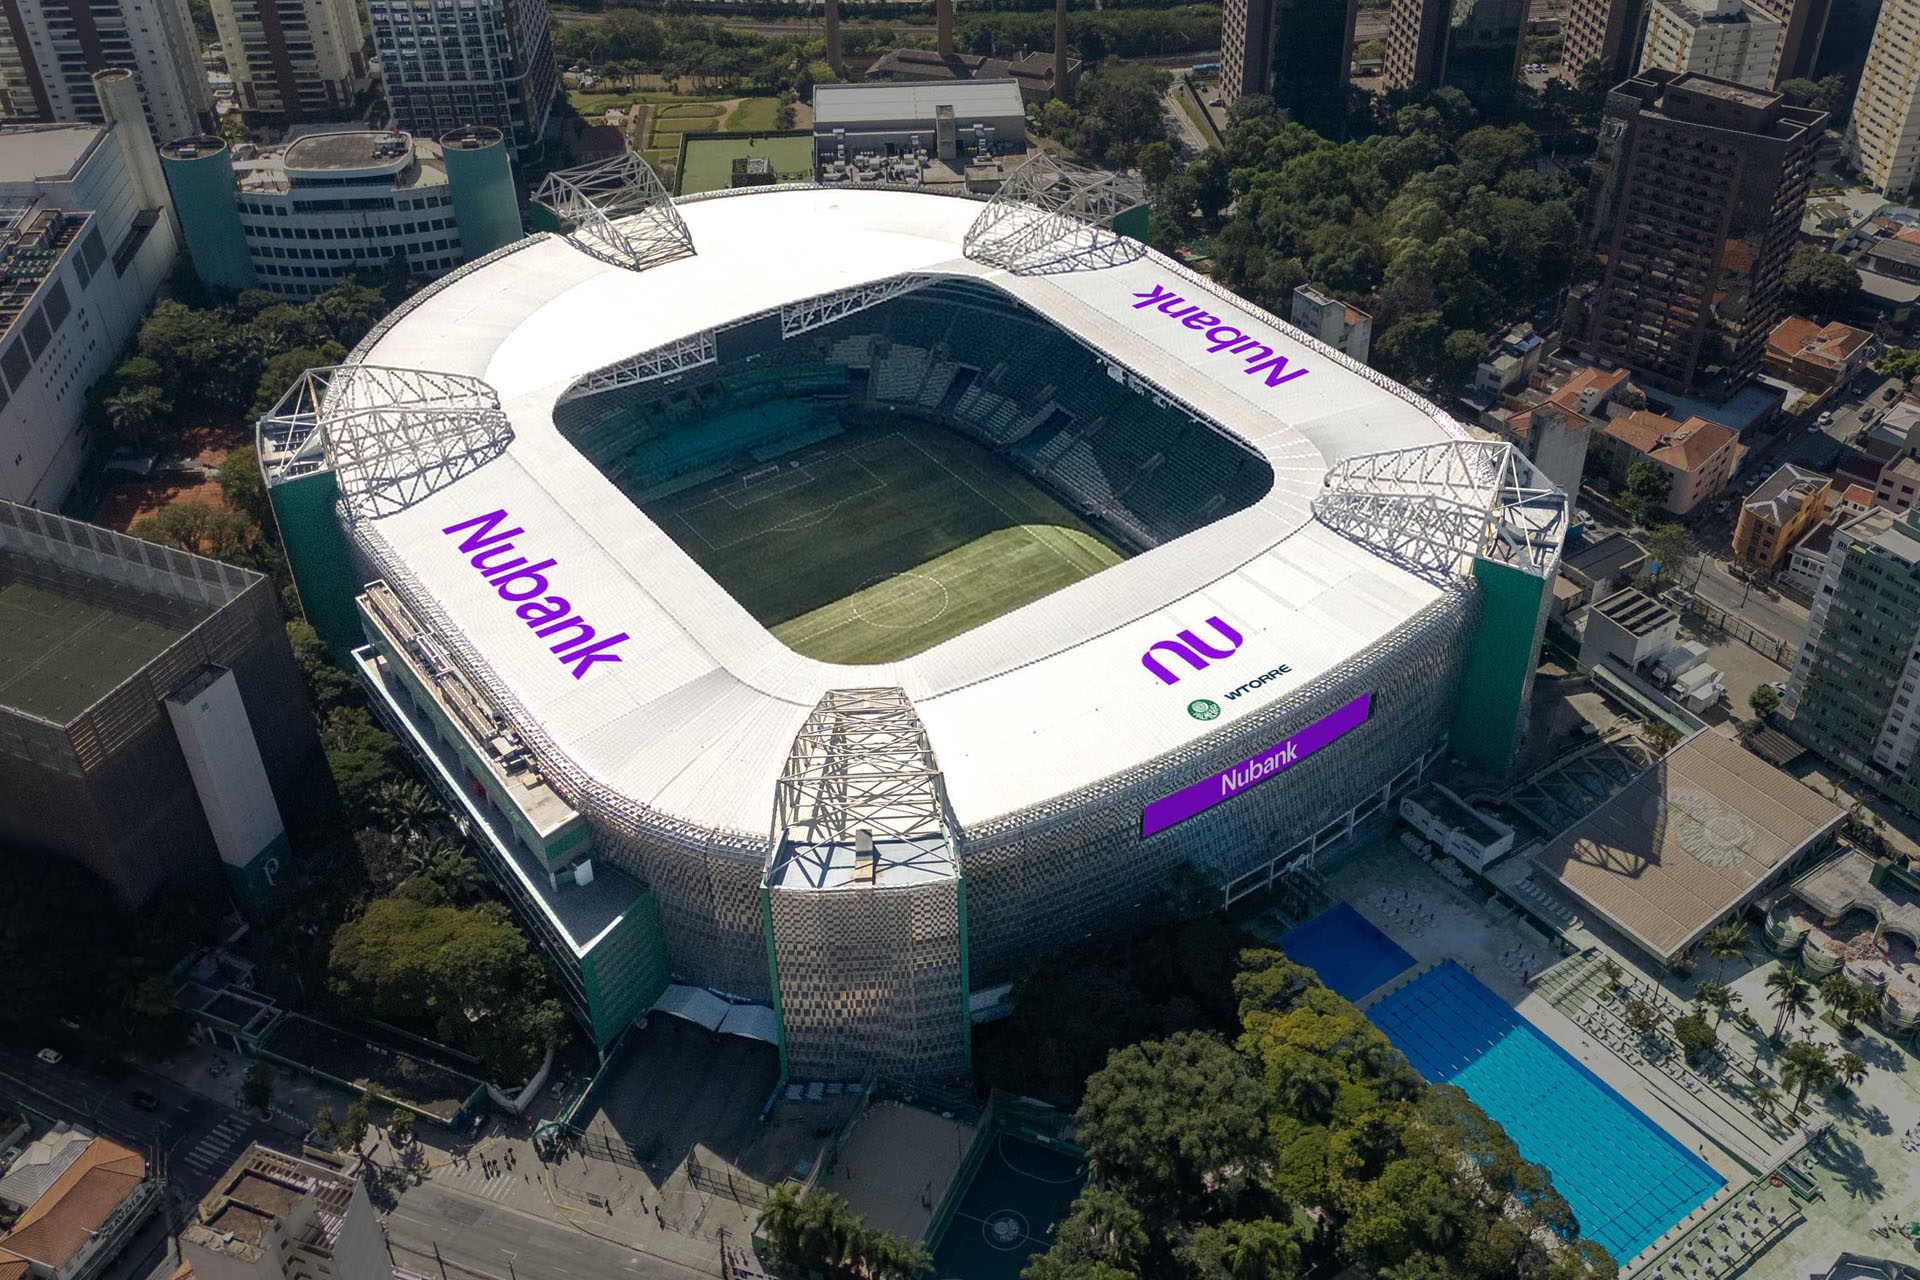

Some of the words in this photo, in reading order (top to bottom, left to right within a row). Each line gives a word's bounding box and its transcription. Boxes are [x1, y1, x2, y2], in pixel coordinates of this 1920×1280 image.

[1132, 284, 1309, 387] Nubank
[442, 509, 630, 680] Nubank
[1224, 664, 1292, 700] WTORRE
[1221, 741, 1298, 795] Nubank
